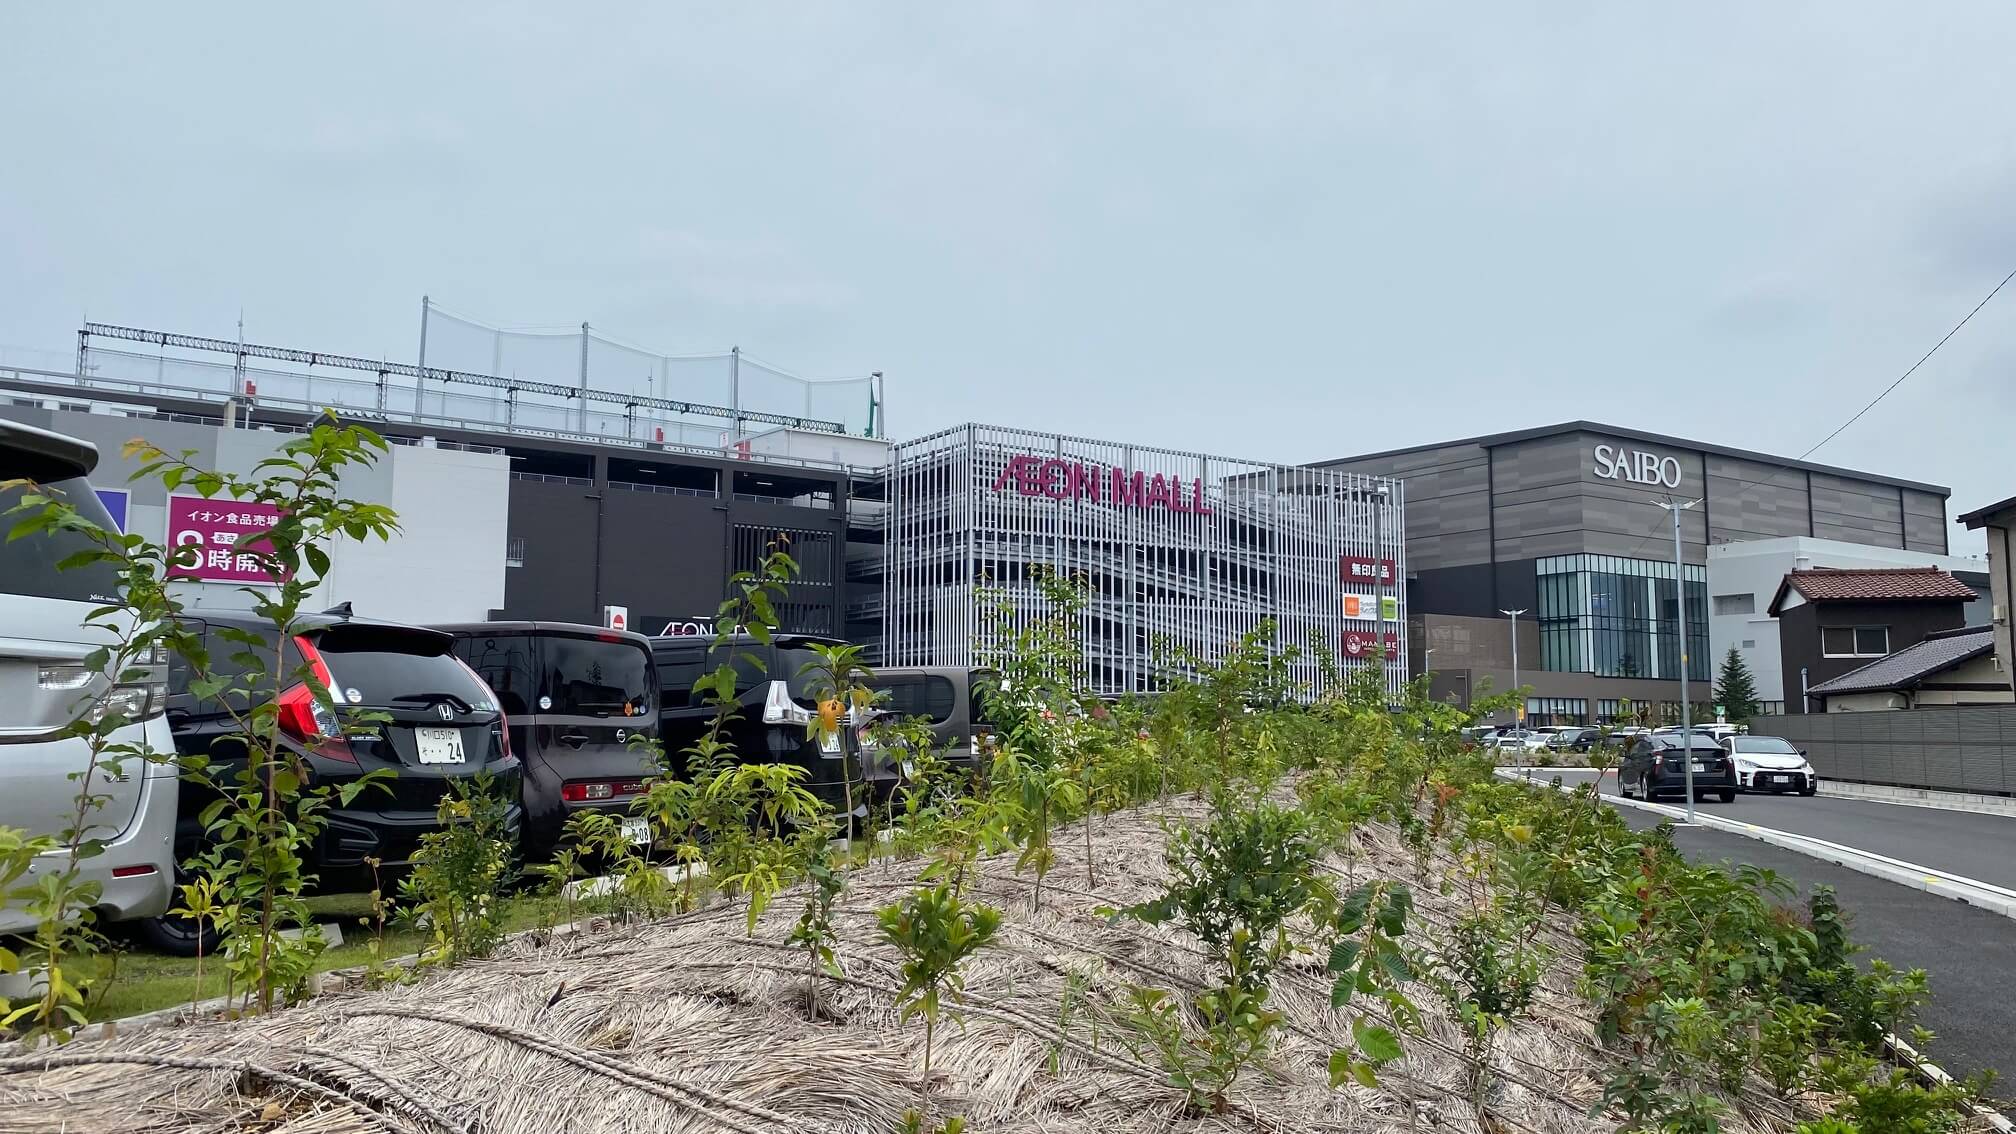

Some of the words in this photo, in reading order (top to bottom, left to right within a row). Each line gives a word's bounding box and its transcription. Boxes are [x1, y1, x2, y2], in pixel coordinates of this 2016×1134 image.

[1593, 444, 1682, 488] SAIBO
[1112, 465, 1213, 515] MALL
[187, 511, 279, 526] イオン食品売場
[1361, 640, 1397, 649] MANBE
